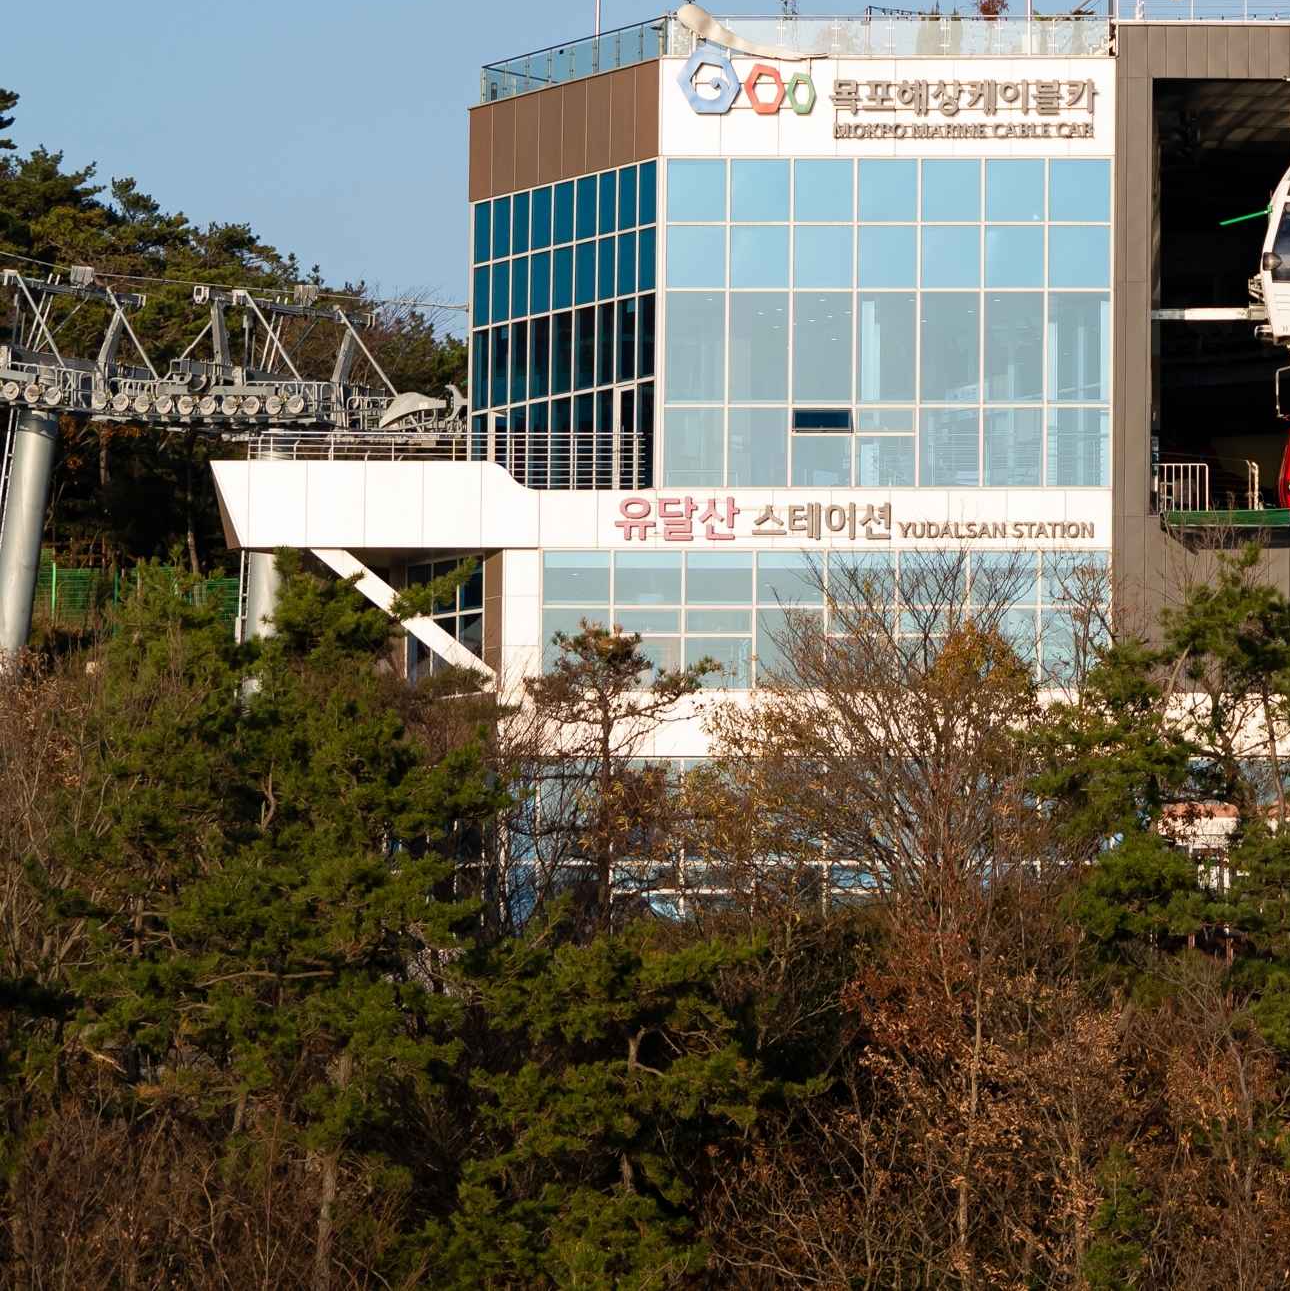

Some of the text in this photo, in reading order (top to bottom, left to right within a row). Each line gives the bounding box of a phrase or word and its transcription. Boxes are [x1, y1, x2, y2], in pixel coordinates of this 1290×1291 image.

[829, 79, 1098, 116] 목포해상케이블카
[833, 122, 1095, 140] MOKPO MARINE CABLE CAR
[614, 496, 892, 541] 유달산 스테이션
[899, 521, 1095, 539] YUDALSAN STATION
